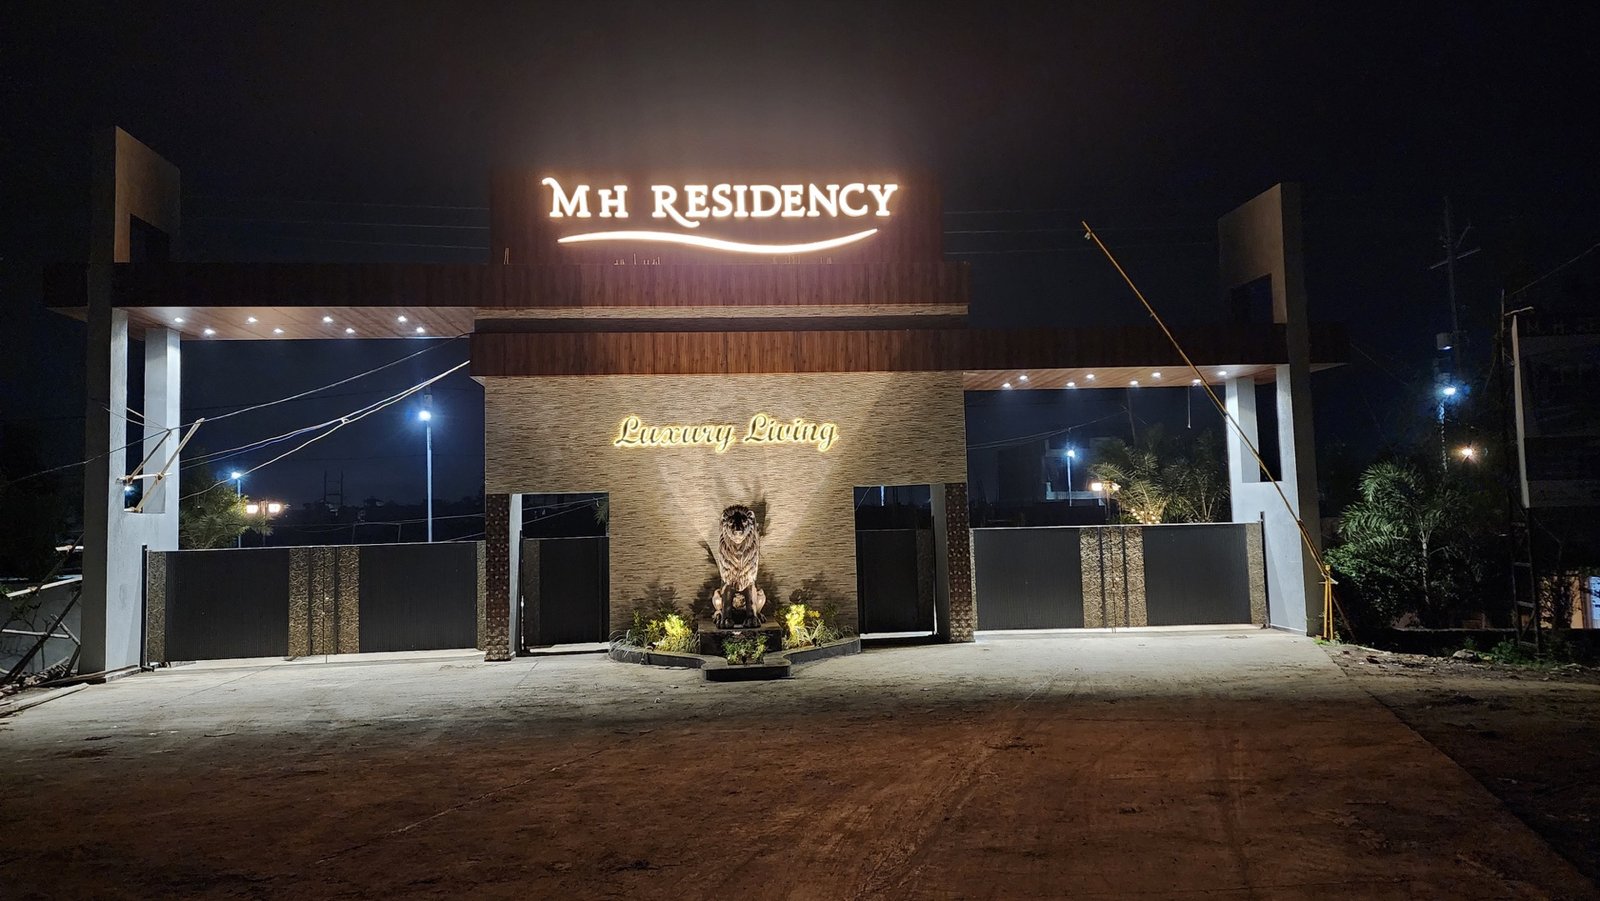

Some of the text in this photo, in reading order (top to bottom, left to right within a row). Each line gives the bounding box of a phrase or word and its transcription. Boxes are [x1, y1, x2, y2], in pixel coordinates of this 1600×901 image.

[542, 177, 899, 228] MH RESIDENCY
[614, 413, 840, 453] Luxury Living
